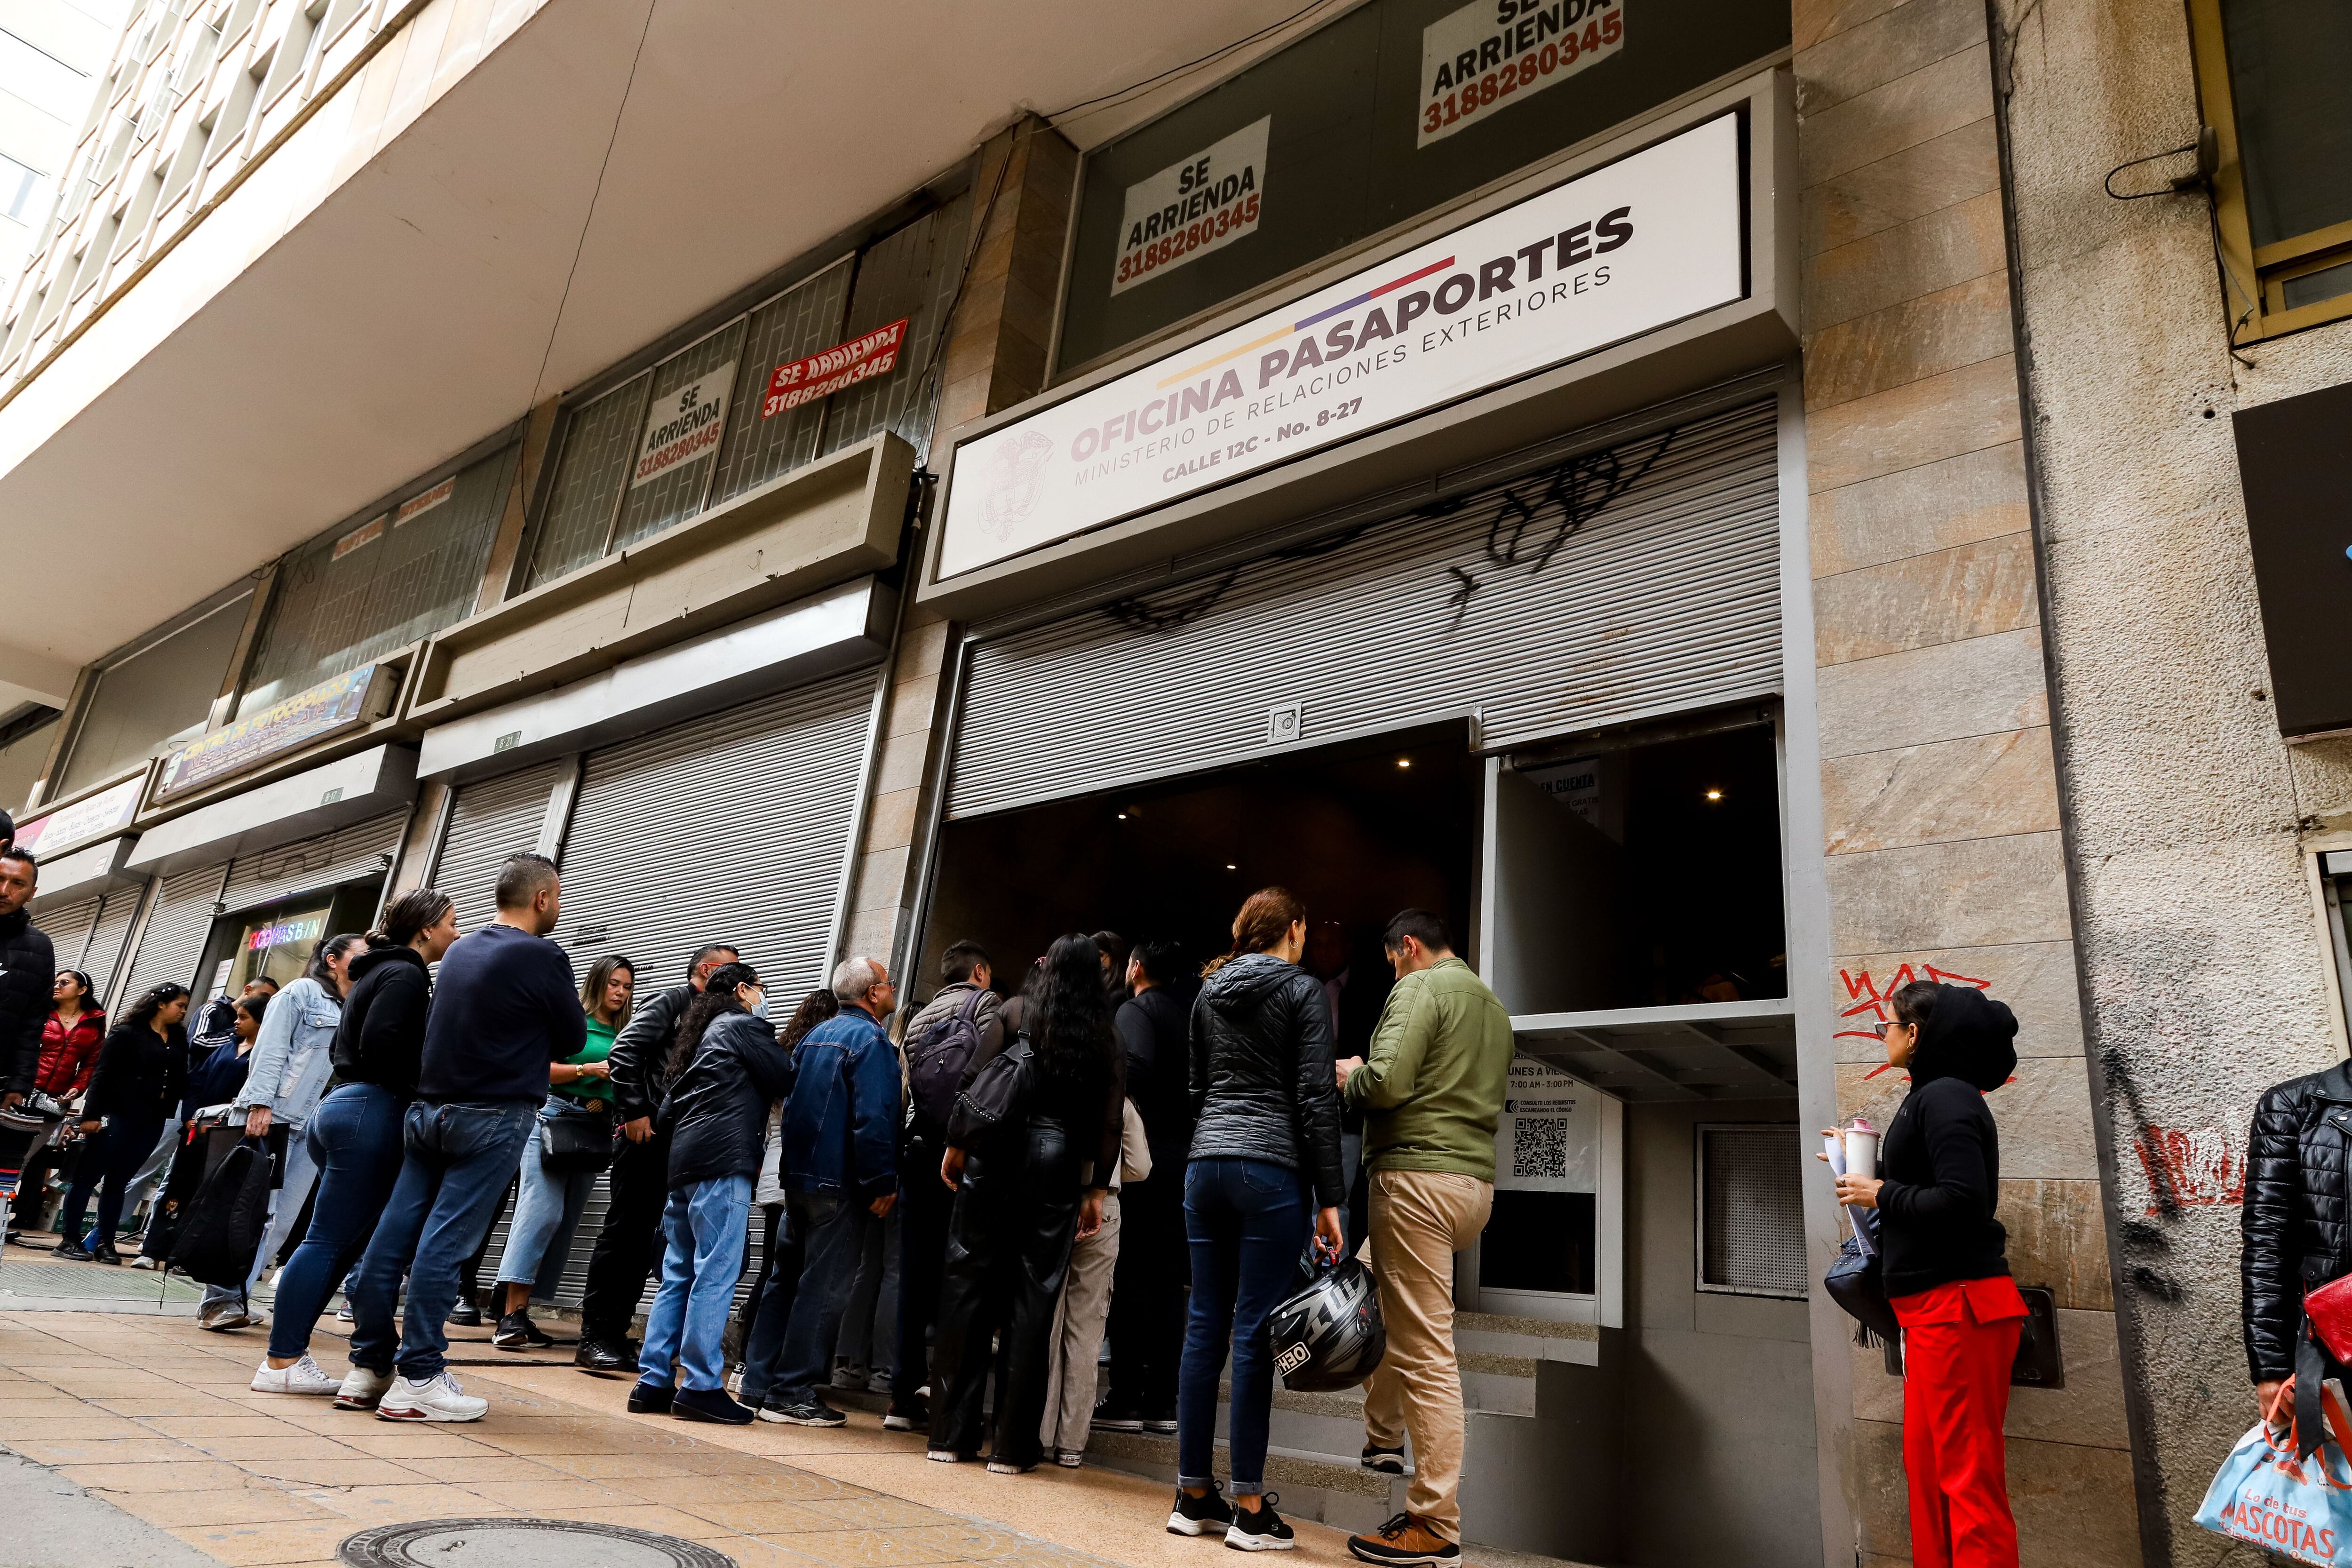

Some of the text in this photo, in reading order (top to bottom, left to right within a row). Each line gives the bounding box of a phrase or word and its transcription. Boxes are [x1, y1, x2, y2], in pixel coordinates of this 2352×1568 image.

[1423, 9, 1622, 133] 3188280345
[1178, 155, 1210, 195] SE
[1126, 165, 1255, 251] ARRIENDA
[1117, 192, 1260, 283] 3188280345
[775, 325, 899, 387] SE ARRIENDA
[1071, 206, 1634, 462] OFICINA PASAPORTES
[679, 385, 700, 413] SE
[764, 350, 895, 416] 3188280345
[1074, 265, 1611, 487] MINISTERIO DE RELACIONES EXTERIORES
[636, 421, 720, 479] 3188280345
[645, 398, 719, 454] ARRIENDA
[1162, 454, 1221, 484] CALLE
[1227, 436, 1259, 459] 12C
[1277, 422, 1310, 441] No.
[1316, 396, 1363, 427] 8-27
[183, 730, 230, 762] CENTRO
[231, 722, 249, 742] DE
[250, 677, 350, 732] FOTOCOPIADO
[499, 735, 514, 748] 8-21
[325, 791, 337, 802] 8-17
[1556, 773, 1595, 791] CUENTA
[1572, 796, 1598, 806] GRATIS
[1508, 1067, 1534, 1076] UNES
[1537, 1067, 1543, 1075] A
[2220, 1502, 2335, 1559] MASCOTAS
[2244, 1488, 2307, 1519] Lo de tus
